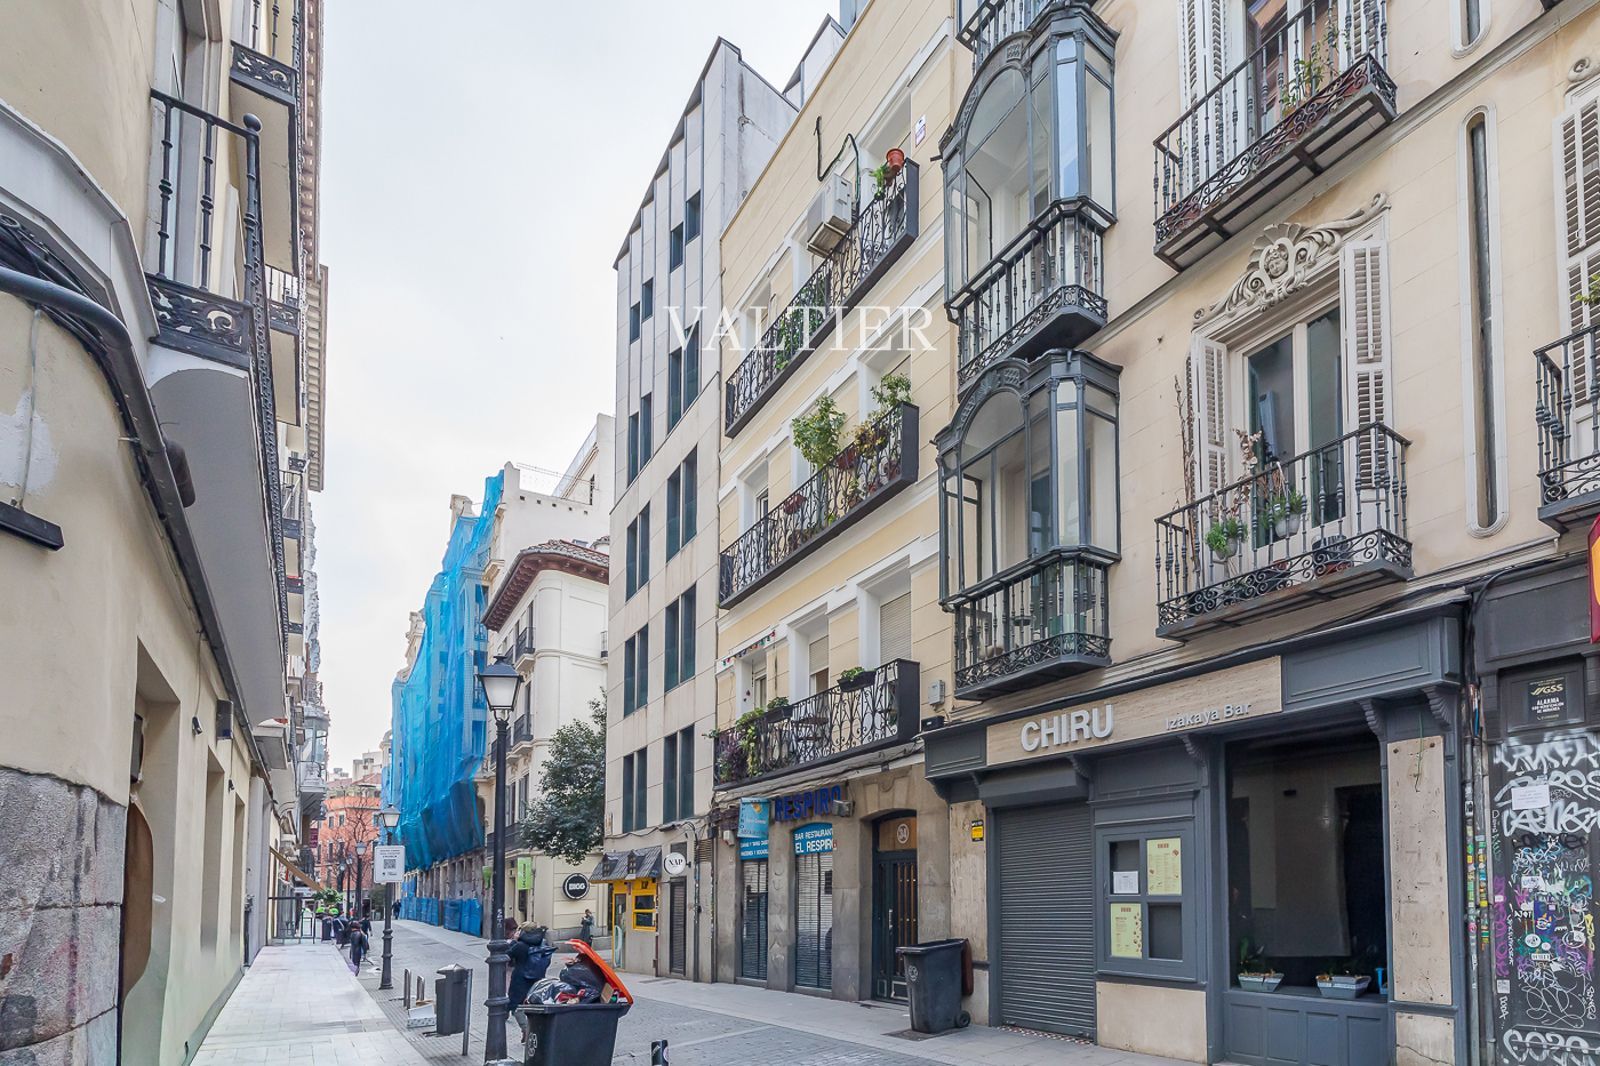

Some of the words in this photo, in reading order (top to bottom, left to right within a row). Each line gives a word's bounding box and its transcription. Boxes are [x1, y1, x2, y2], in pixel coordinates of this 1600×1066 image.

[1020, 703, 1115, 753] CHIRU
[1166, 709, 1220, 731] Izakaya
[1222, 702, 1252, 719] Bar
[795, 842, 804, 854] EL
